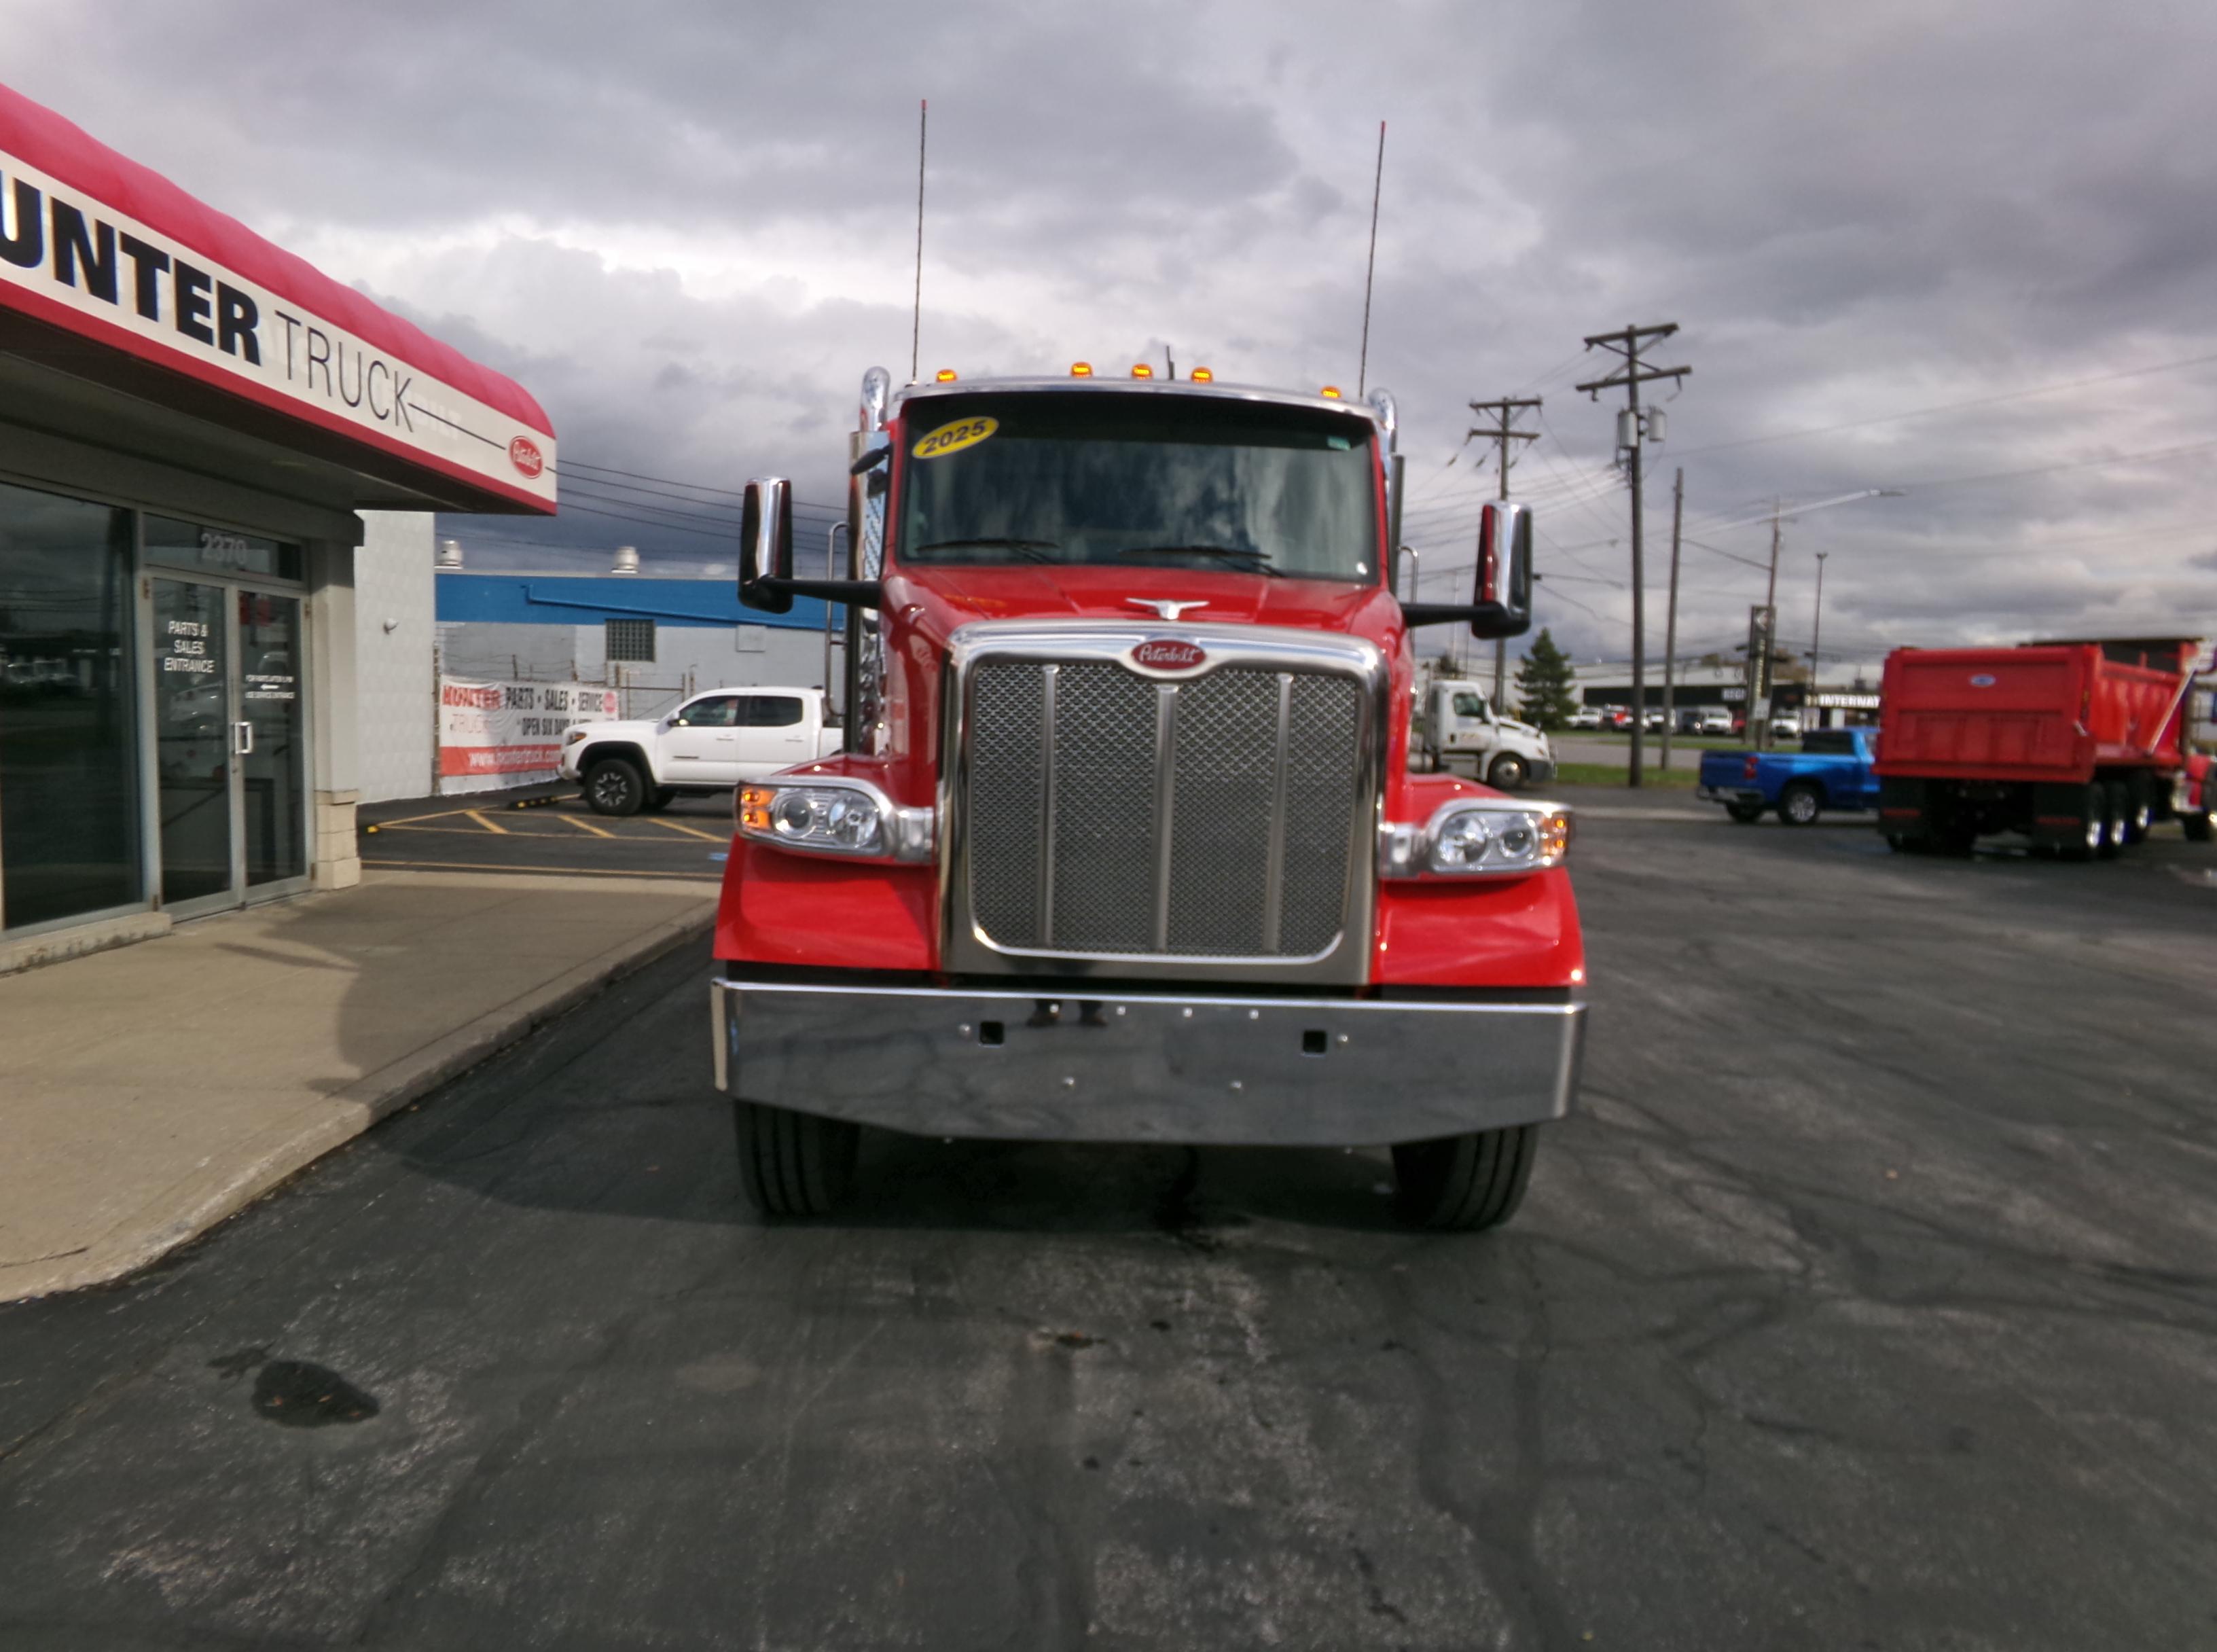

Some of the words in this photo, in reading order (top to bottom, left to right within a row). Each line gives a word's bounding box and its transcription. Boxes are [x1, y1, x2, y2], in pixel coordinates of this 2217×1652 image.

[274, 309, 413, 433] TRUCK
[922, 419, 987, 454] 2025
[168, 621, 200, 636] PARTS
[200, 625, 209, 637] &
[174, 640, 205, 655] SALES
[1138, 643, 1202, 662] Peterbilt
[164, 658, 215, 673] ENTRANCE
[443, 685, 501, 711] HUNTER
[505, 687, 534, 710] PARTS
[545, 689, 568, 711] SALES
[578, 692, 602, 712] SERVICE
[522, 717, 540, 736] OPEN
[543, 718, 552, 735] SIX
